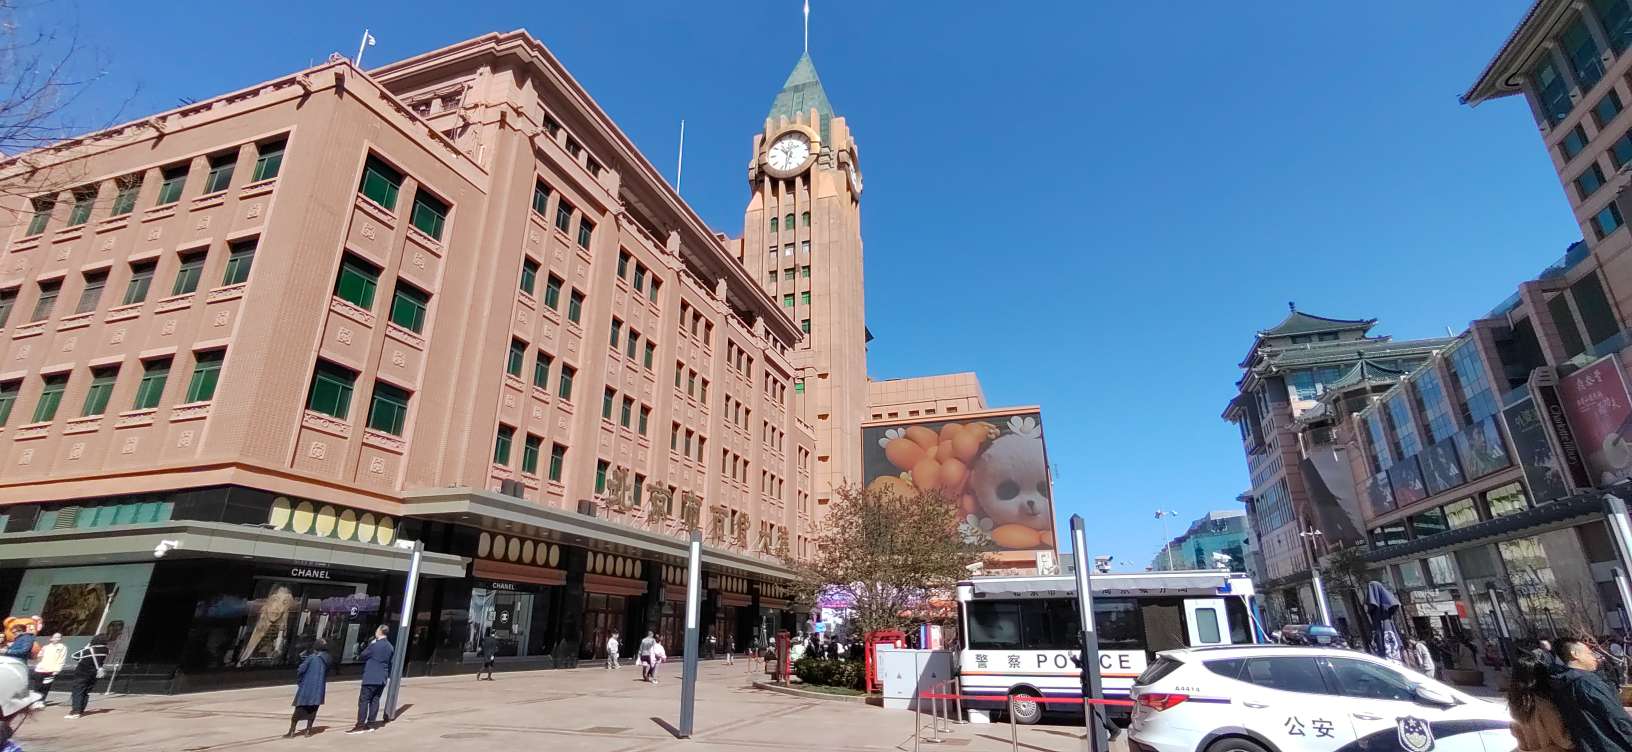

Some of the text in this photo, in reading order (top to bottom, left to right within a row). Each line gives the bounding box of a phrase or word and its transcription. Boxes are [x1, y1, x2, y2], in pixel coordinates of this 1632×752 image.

[291, 568, 330, 579] CHANEL
[492, 582, 515, 590] CHANEL
[975, 653, 1021, 669] 警察
[1037, 654, 1131, 669] POCE
[1284, 716, 1335, 739] 公安
